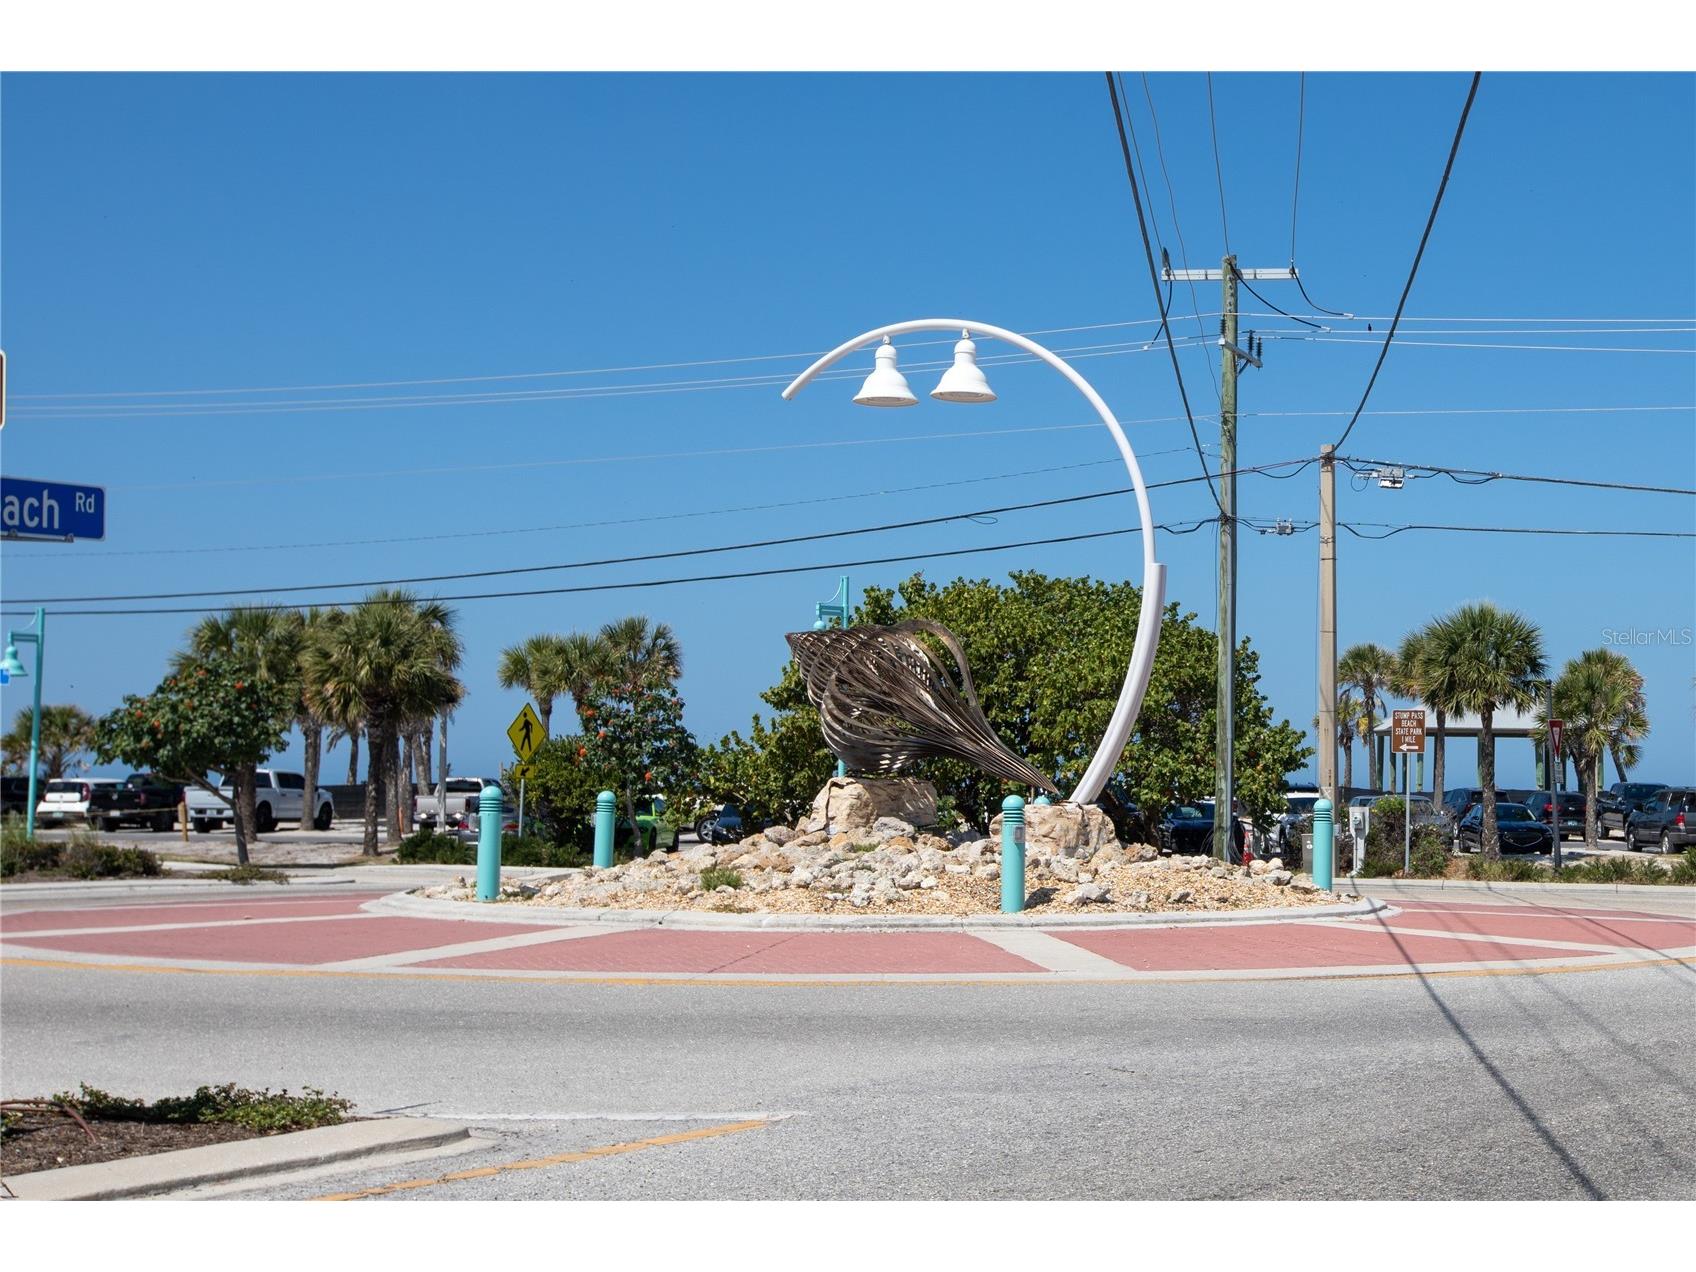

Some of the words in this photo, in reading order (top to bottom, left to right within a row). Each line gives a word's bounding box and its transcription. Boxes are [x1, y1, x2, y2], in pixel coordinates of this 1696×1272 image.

[75, 491, 95, 513] Rd
[1394, 712, 1410, 720] STUMP
[1411, 712, 1423, 720] PASS
